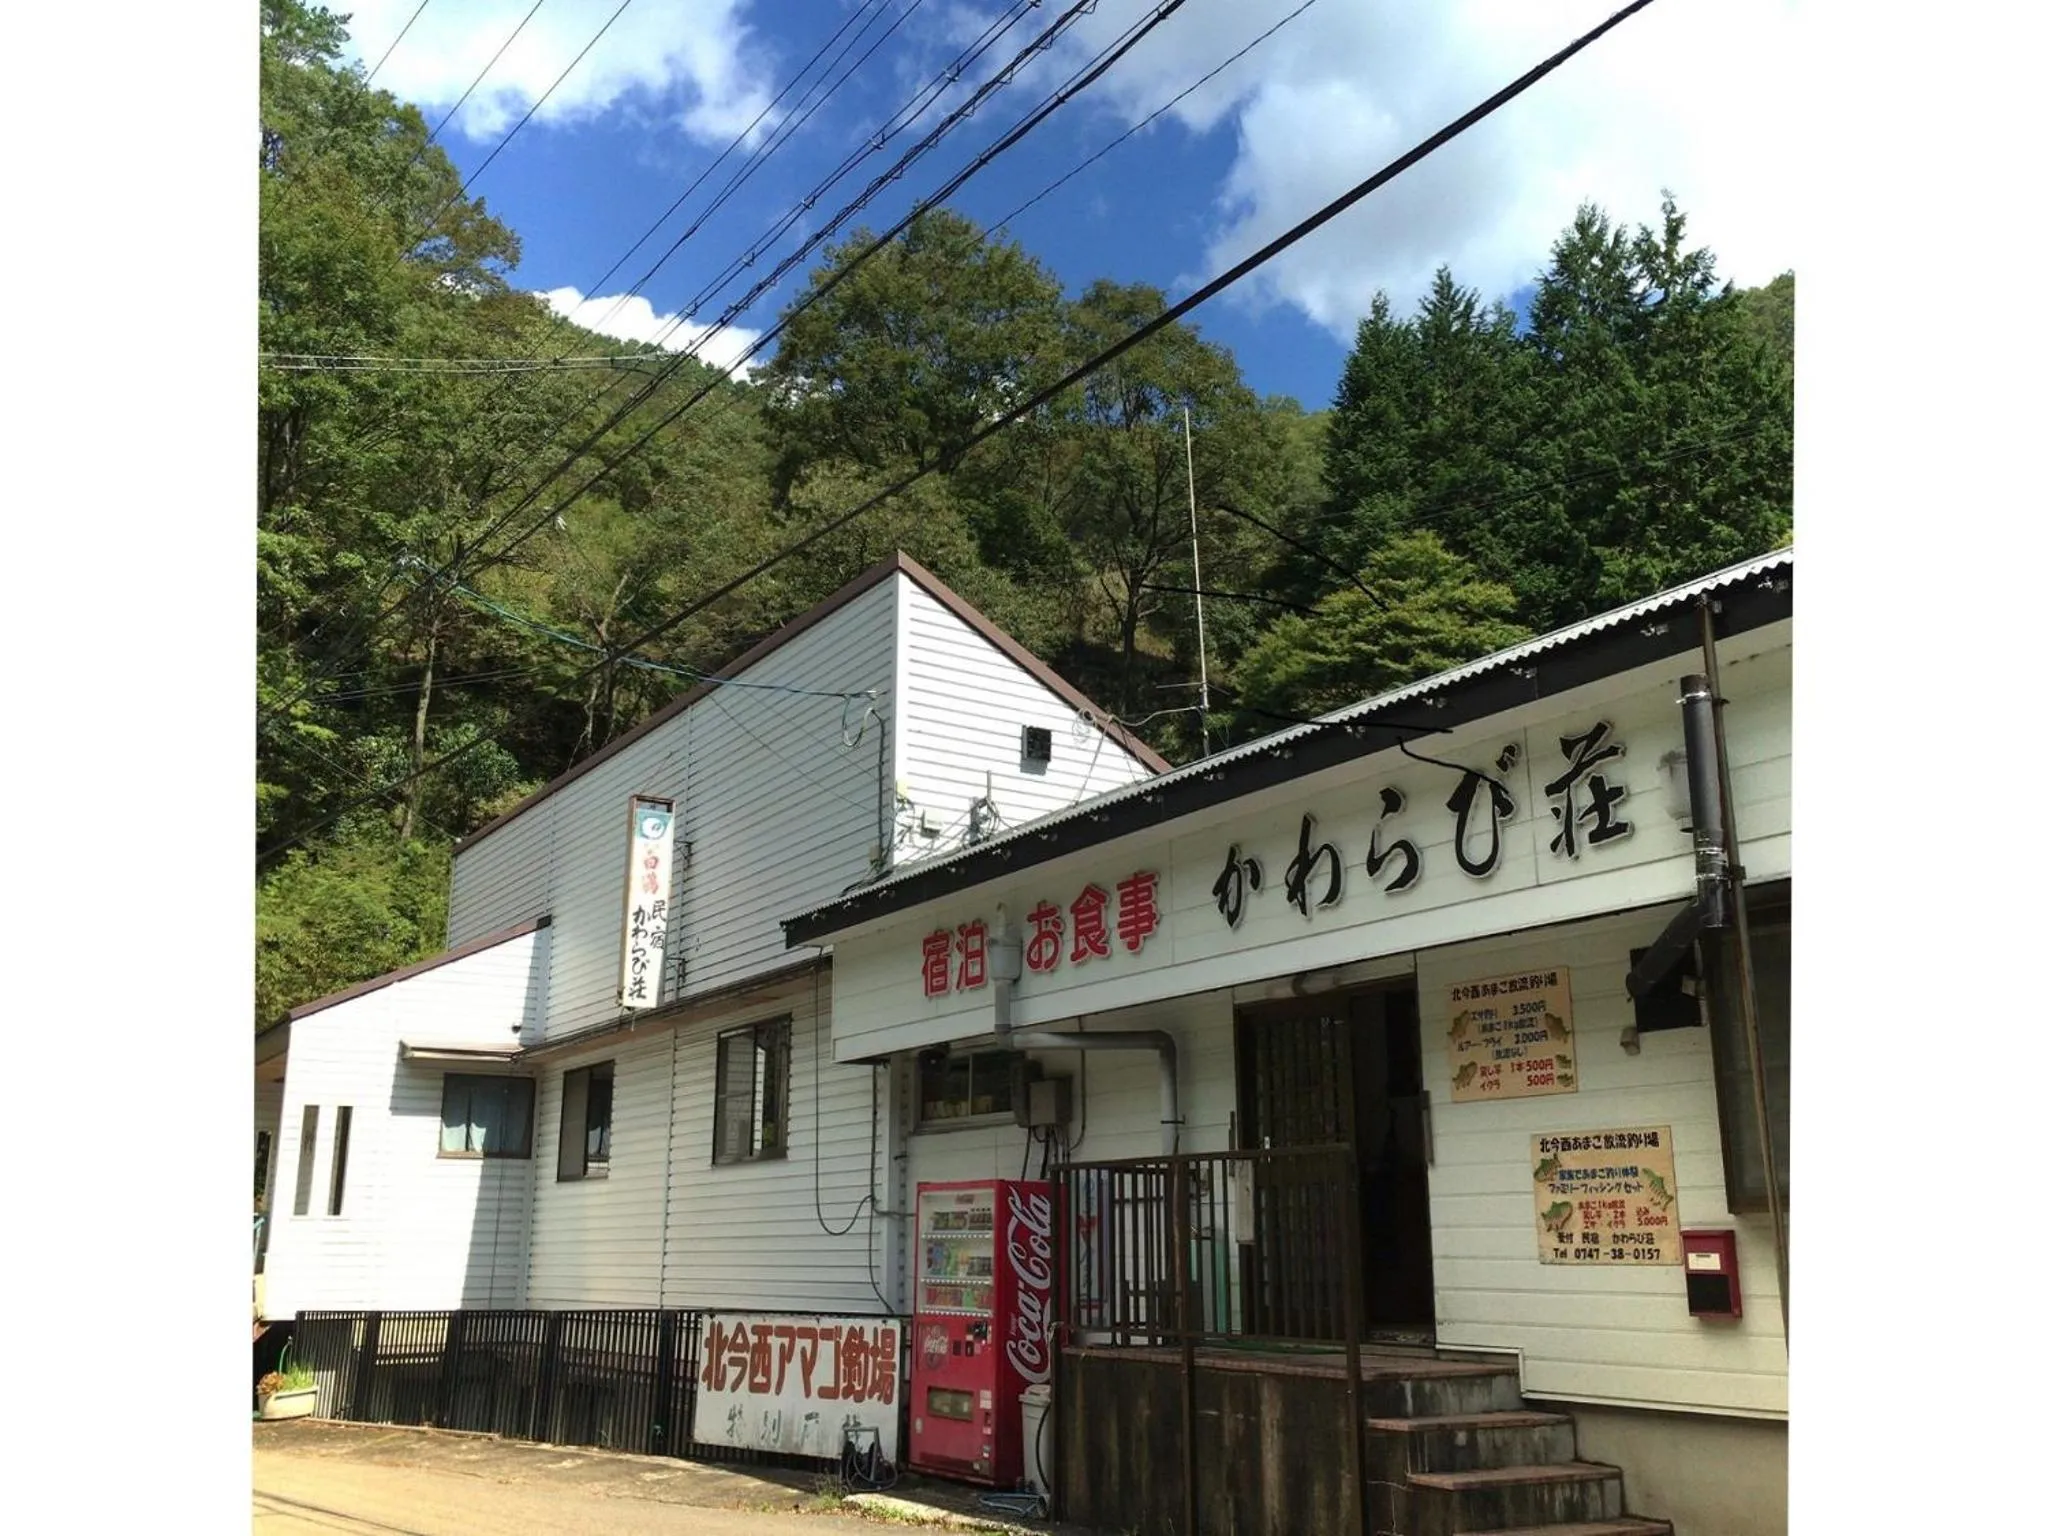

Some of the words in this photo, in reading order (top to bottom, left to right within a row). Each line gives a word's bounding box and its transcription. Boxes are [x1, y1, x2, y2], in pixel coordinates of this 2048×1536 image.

[921, 919, 990, 997] 宿泊
[1026, 871, 1160, 972] お食事
[1212, 721, 1634, 928] かわらび荘
[629, 904, 650, 1000] かわらび荘
[650, 900, 667, 950] 民宿
[1527, 1073, 1555, 1087] 500円
[1006, 1185, 1051, 1384] Coca-Cola
[1553, 1248, 1567, 1259] Tel
[702, 1321, 896, 1405] 北今西アマゴ釣場
